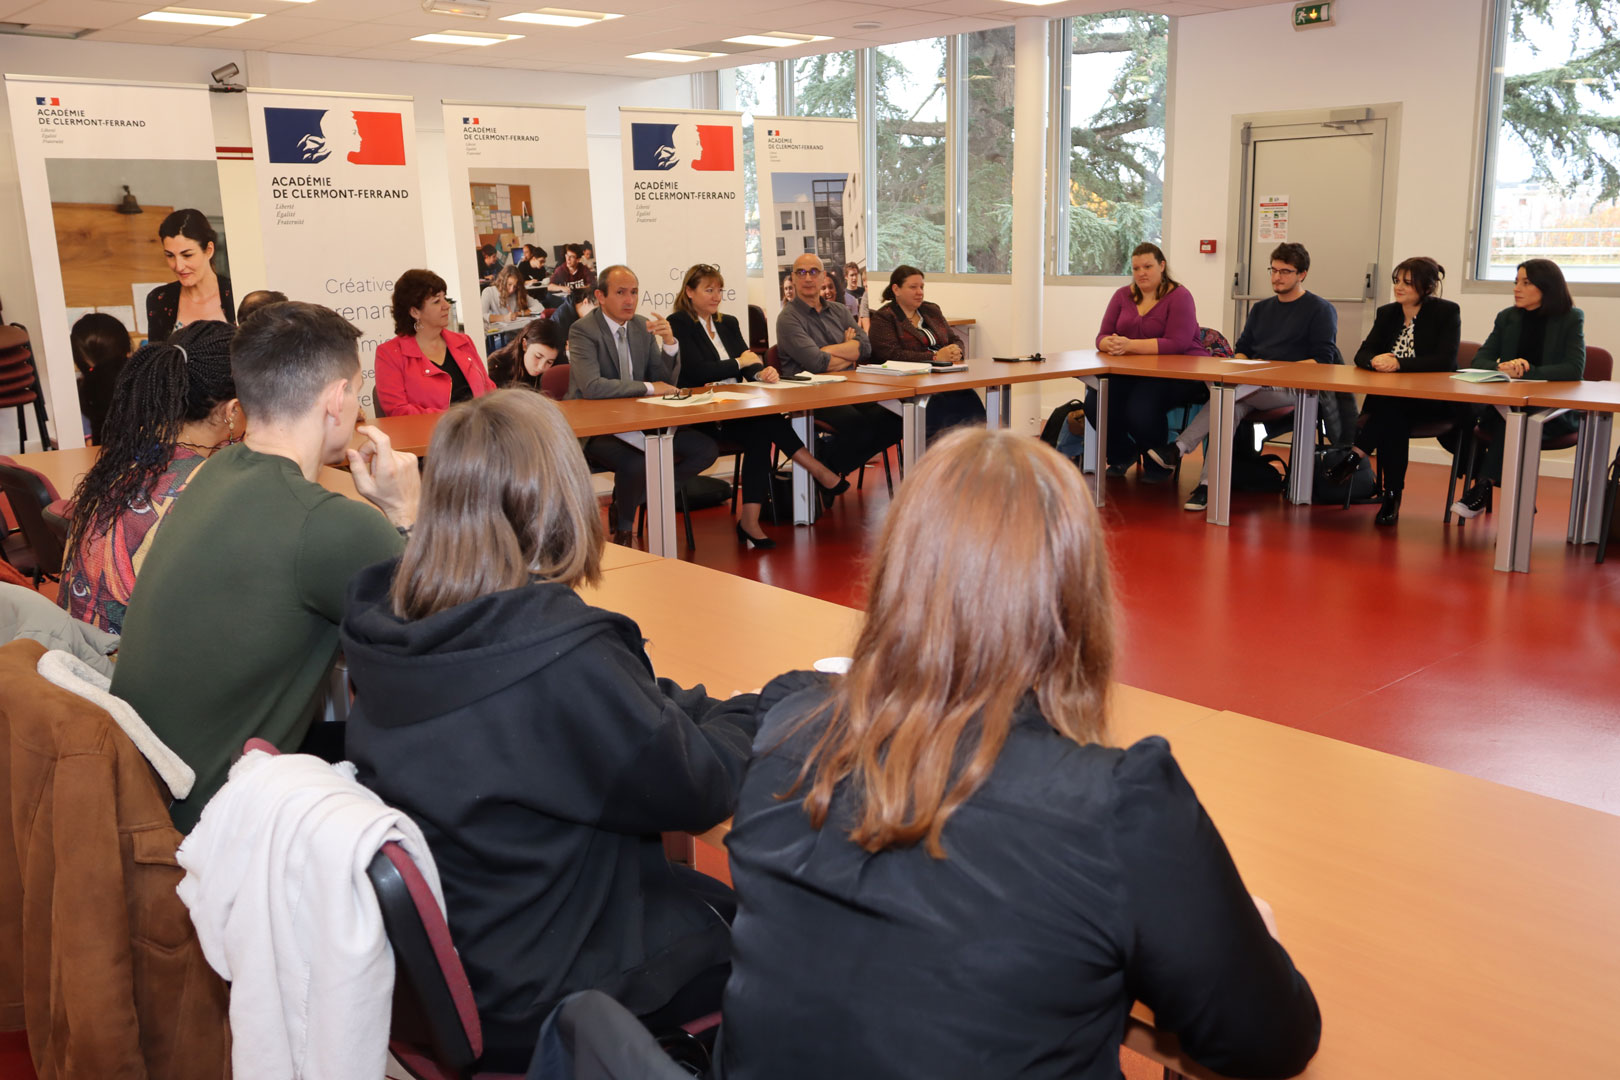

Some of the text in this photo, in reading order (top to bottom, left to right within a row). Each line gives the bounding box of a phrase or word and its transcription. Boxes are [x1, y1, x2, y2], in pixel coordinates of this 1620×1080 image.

[37, 108, 85, 117] ACADÉMIE
[38, 117, 146, 127] DE CLERMONT-FERRAND
[474, 134, 539, 142] CLERMONT-FERRAND
[272, 175, 332, 186] ACADÉMIE
[634, 180, 679, 190] ACADÉMIE
[273, 189, 409, 199] DE CLERMONT-FERRAND
[635, 191, 736, 200] DE CLERMONT-FERRAND
[325, 277, 394, 294] Créative
